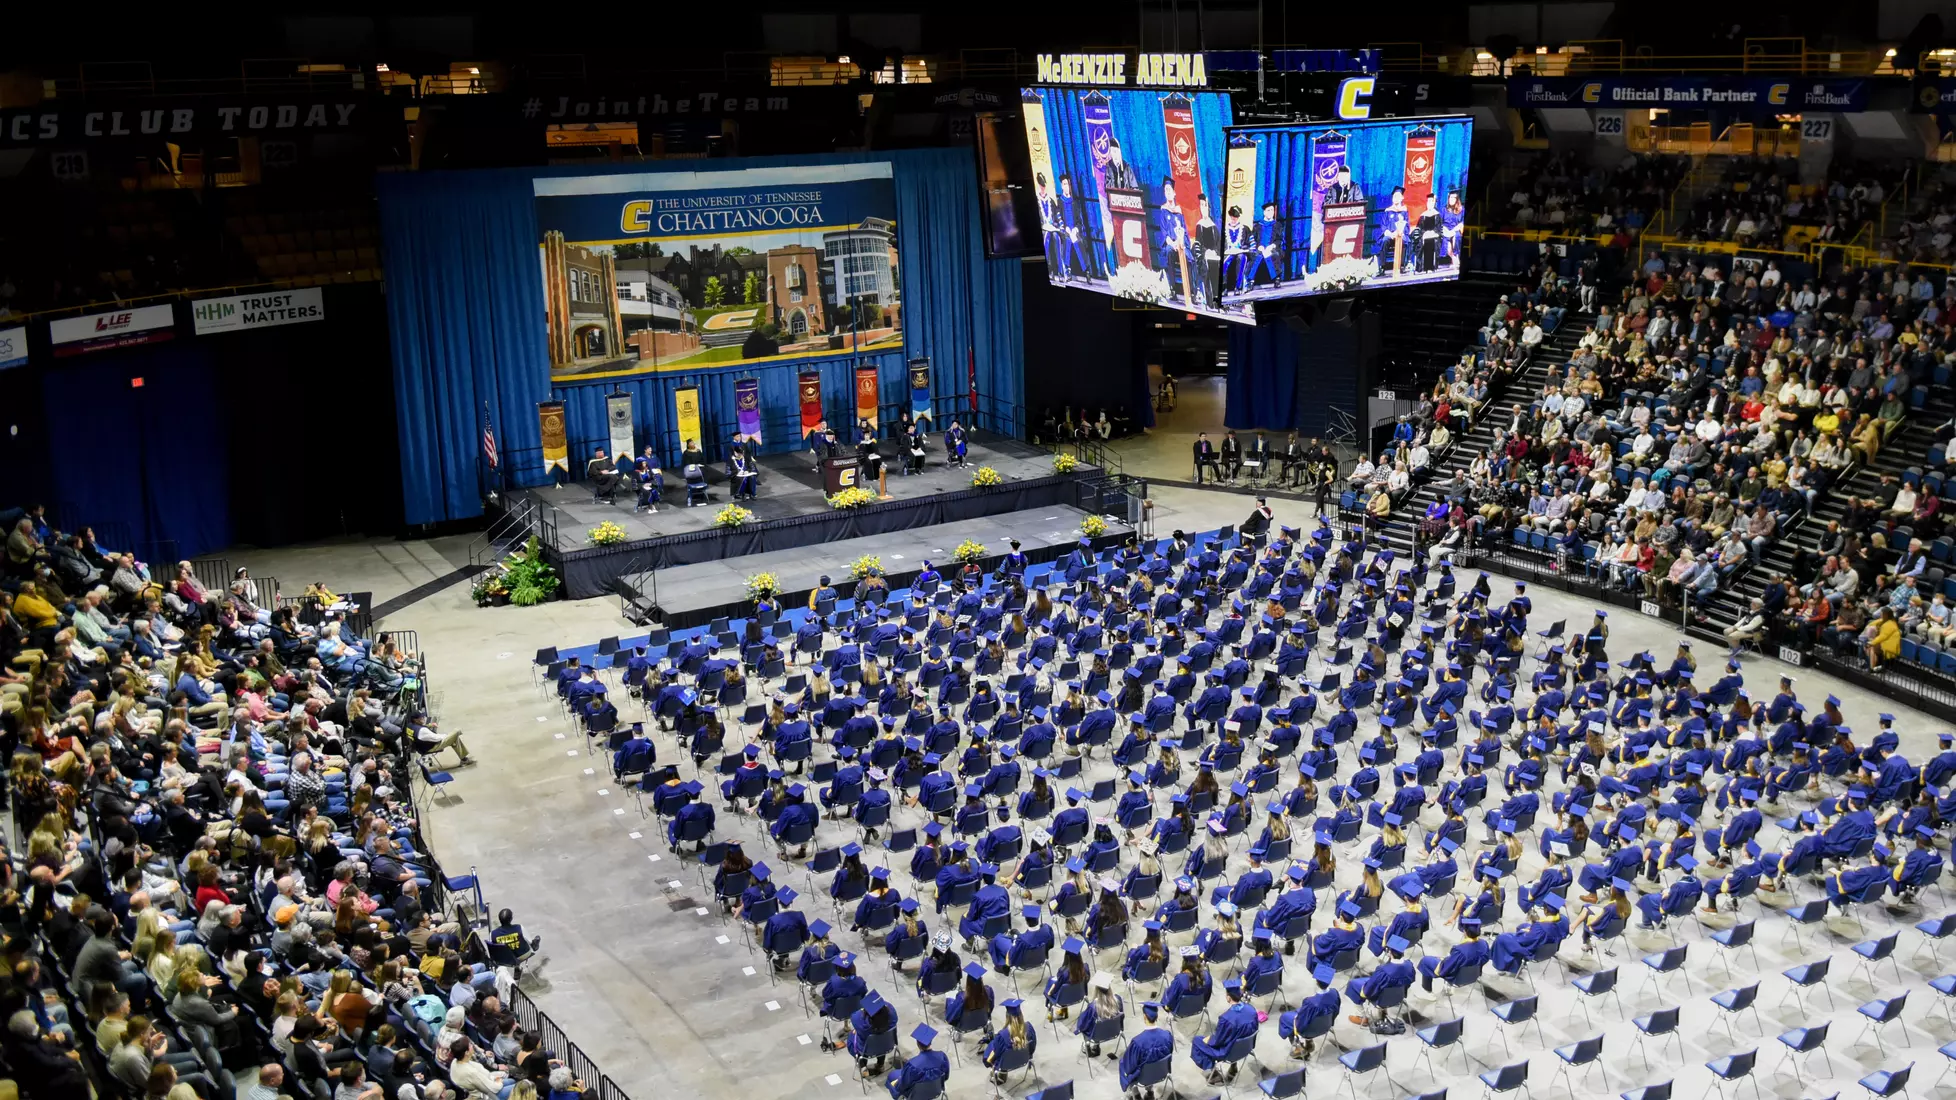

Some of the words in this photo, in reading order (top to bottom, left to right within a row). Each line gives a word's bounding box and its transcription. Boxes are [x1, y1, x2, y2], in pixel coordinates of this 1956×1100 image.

[1037, 54, 1126, 84] McKENZIE
[1137, 54, 1207, 85] ARENA
[1525, 90, 1568, 102] FirstBank
[1612, 87, 1660, 101] Official
[1663, 87, 1699, 101] Bank
[1702, 87, 1757, 102] Partner
[1804, 91, 1851, 105] FirstBank
[0, 114, 59, 142] CS
[85, 108, 195, 137] CLUB
[218, 103, 357, 131] TODAY
[1598, 117, 1622, 132] 226
[1804, 121, 1830, 137] 227
[657, 199, 680, 209] THE
[682, 194, 747, 208] UNIVERSITY
[749, 193, 763, 204] OF
[764, 190, 822, 203] TENNESSEE
[657, 205, 824, 233] CHATTANOOGA
[241, 295, 292, 310] TRUST
[109, 313, 132, 325] LEE
[196, 303, 235, 320] HHM
[243, 305, 322, 324] MATTERS.
[1643, 602, 1657, 615] 127
[1782, 649, 1798, 663] 102
